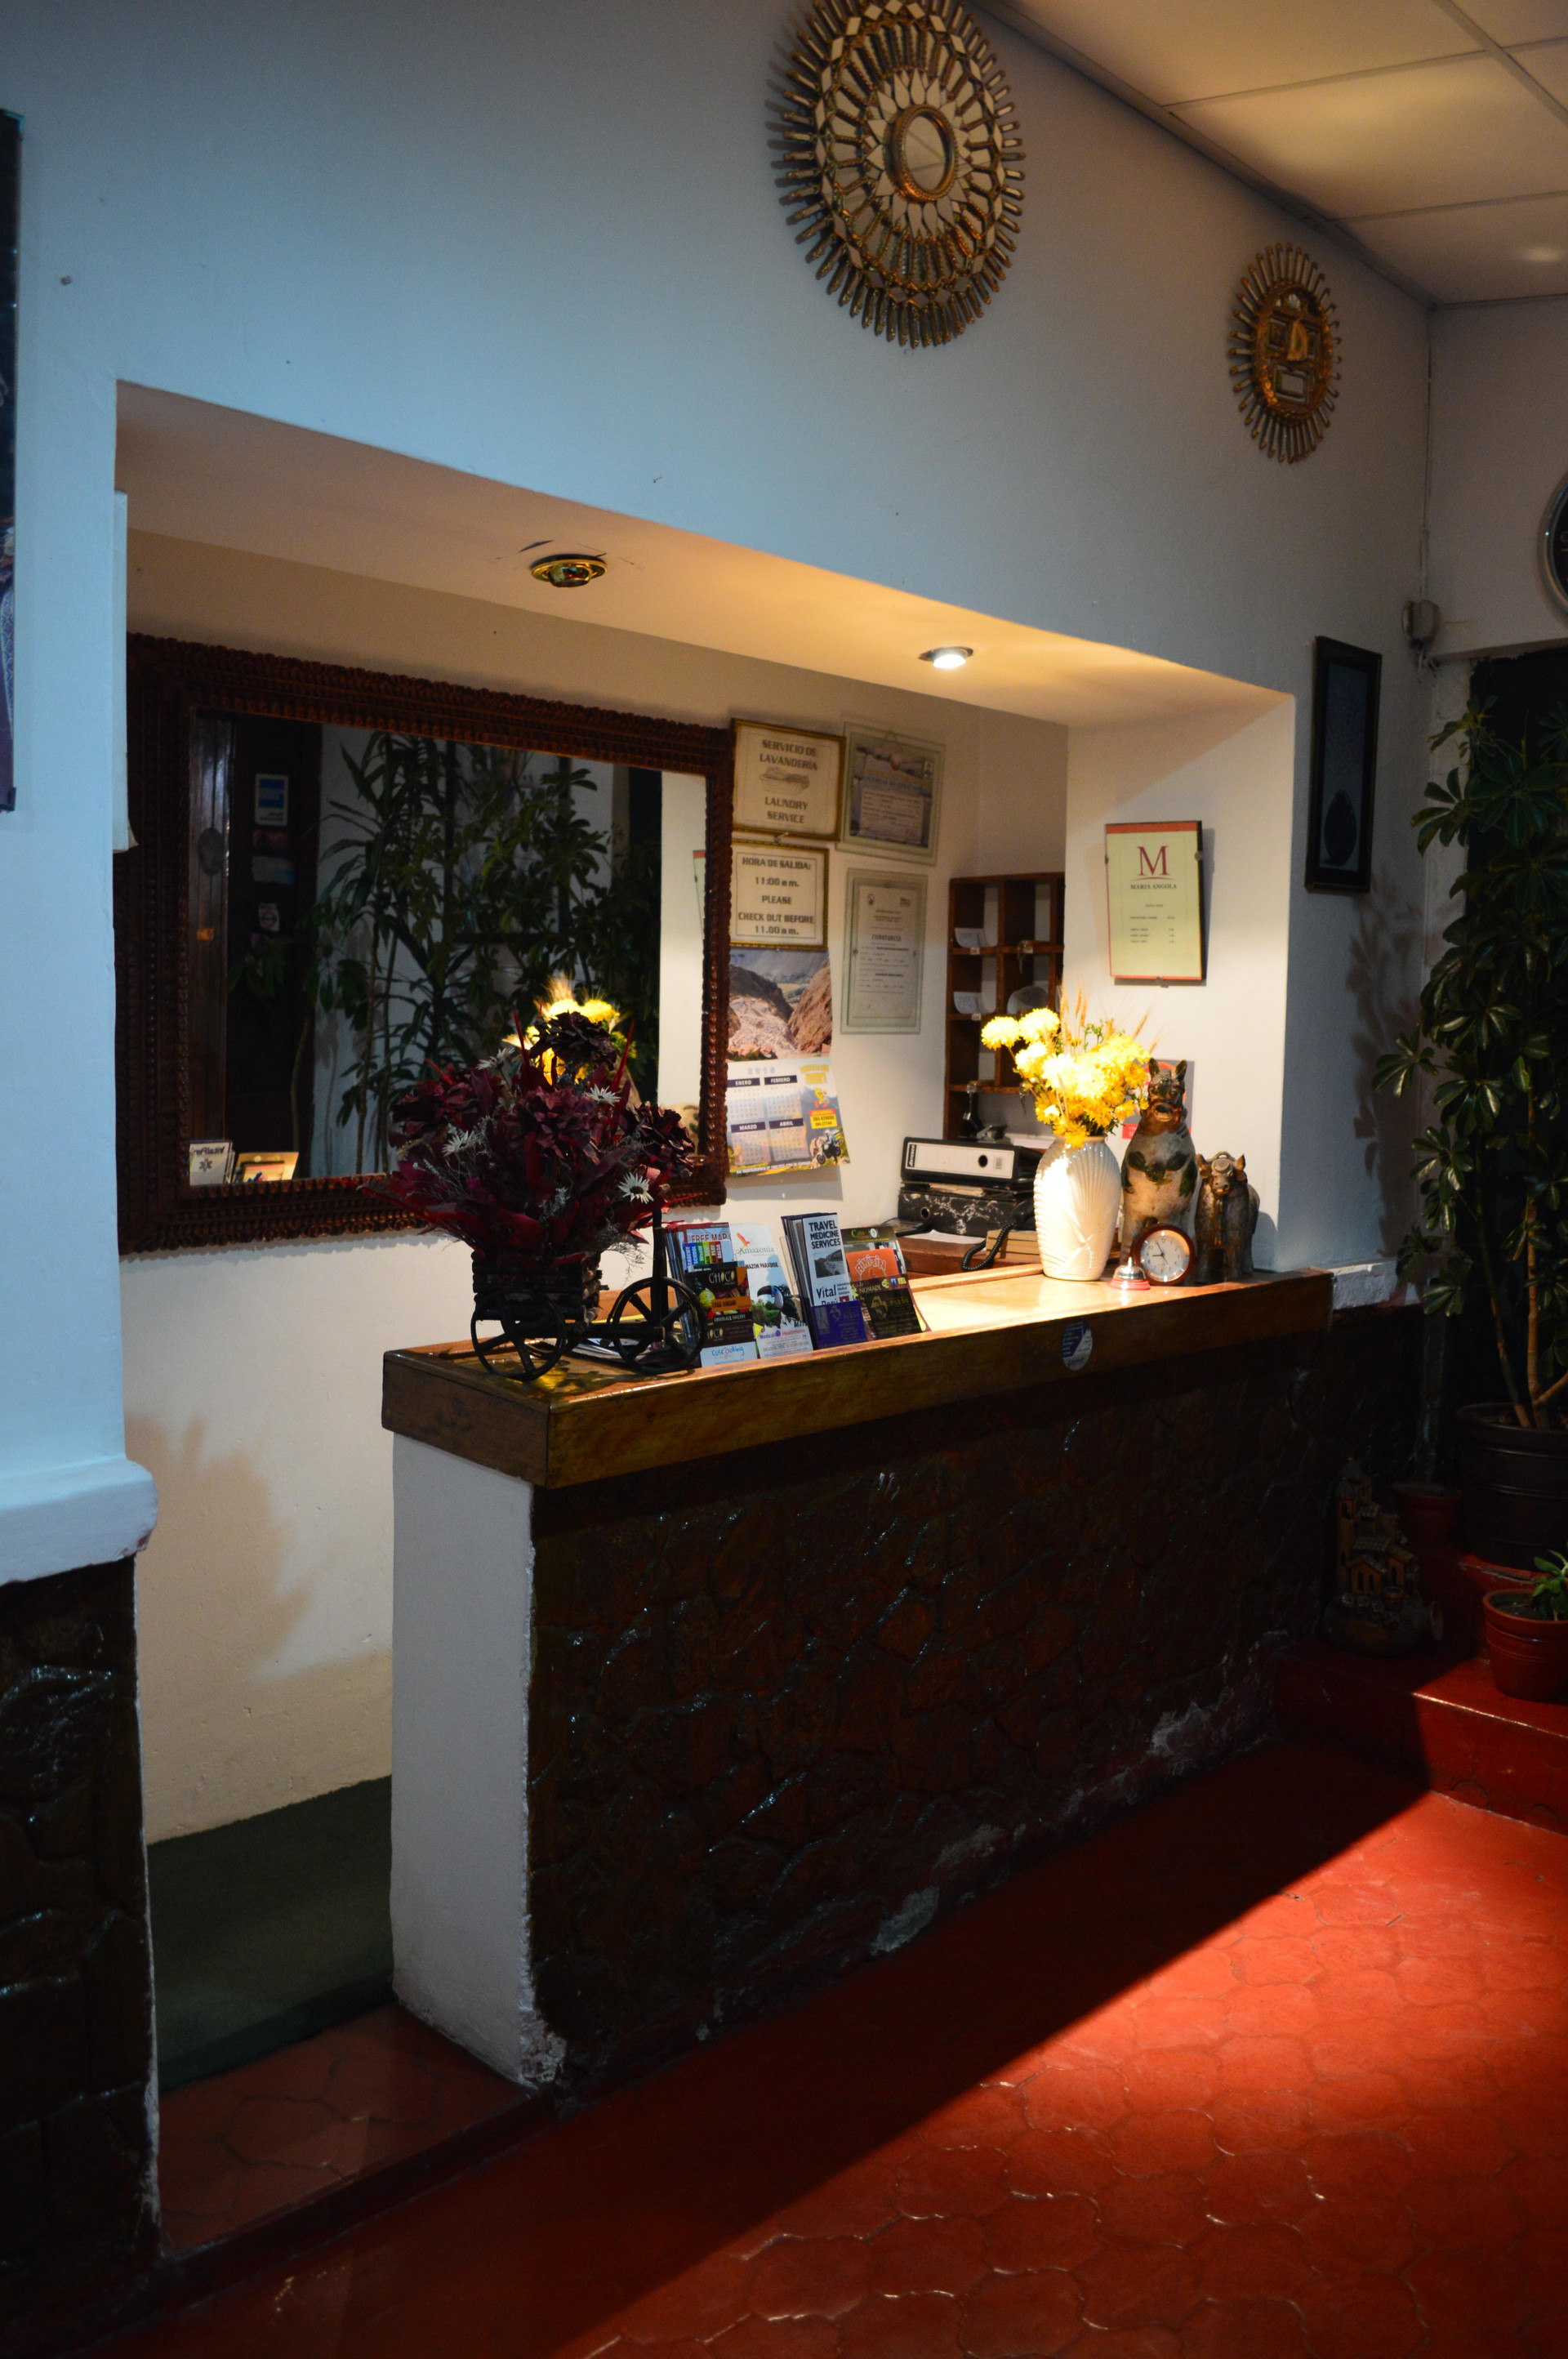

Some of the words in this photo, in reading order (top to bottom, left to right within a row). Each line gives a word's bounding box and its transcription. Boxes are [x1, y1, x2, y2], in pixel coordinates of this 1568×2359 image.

[762, 739, 804, 754] SERVICIO
[805, 746, 817, 756] DE
[760, 753, 817, 770] LAVANDERÍA
[764, 796, 808, 811] LAUNDRY
[767, 810, 804, 824] SERVICE
[742, 857, 765, 867] HORA
[768, 858, 777, 867] DE
[779, 860, 811, 870] SALIDA:
[1137, 845, 1169, 876] M
[755, 877, 780, 886] 11:00
[761, 894, 792, 905] PLEASE
[738, 912, 764, 921] CHECK
[766, 913, 782, 923] OUT
[784, 914, 814, 924] BEFORE
[808, 1220, 838, 1232] TRAVEL
[810, 1230, 840, 1241] MEDICINE
[812, 1238, 841, 1250] SERVICES
[816, 1285, 837, 1299] Vital
